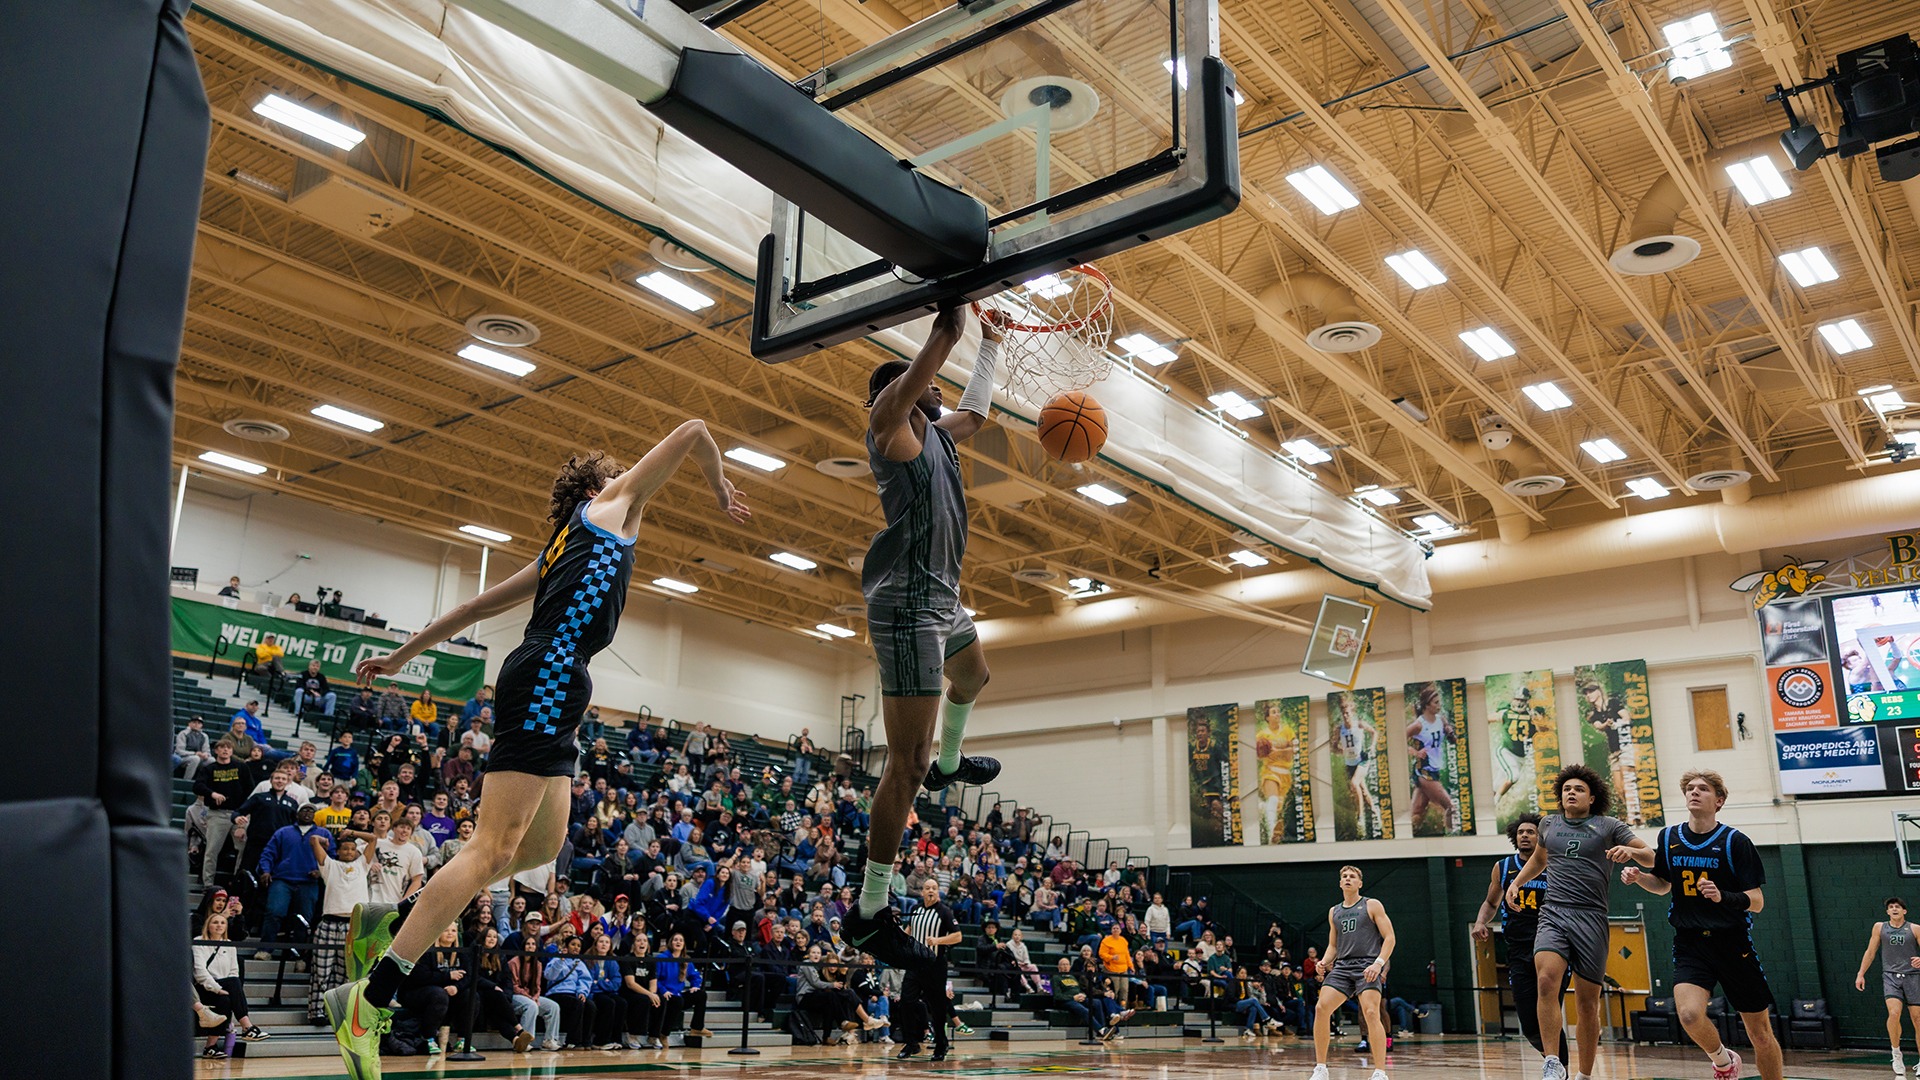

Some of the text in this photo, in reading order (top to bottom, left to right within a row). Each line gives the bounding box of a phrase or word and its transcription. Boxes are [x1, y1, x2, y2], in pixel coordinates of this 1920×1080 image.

[1884, 531, 1920, 567] B
[1783, 625, 1819, 634] Interstate
[322, 643, 347, 664] TO
[401, 661, 434, 679] RENA
[1783, 691, 1821, 707] INCORPORATED
[1881, 695, 1904, 704] REBS
[1886, 706, 1903, 716] 23
[1431, 730, 1441, 748] H
[1508, 719, 1530, 742] 43
[1345, 734, 1355, 748] H
[1783, 740, 1875, 752] ORTHOPEDICS AND
[1455, 737, 1469, 773] CROSS
[1782, 747, 1875, 760] SPORTS MEDICINE
[1227, 707, 1243, 844] MEN'S BASKETBALL
[1298, 702, 1314, 840] WOMEN'S BASKETBALL
[1377, 754, 1390, 795] CROSS
[1632, 725, 1663, 821] WOMEN'S
[1458, 777, 1473, 832] WOMEN'S
[1295, 796, 1305, 841] YELLOW
[1380, 797, 1393, 840] MEN'S
[1564, 839, 1581, 858] 2
[1672, 855, 1720, 869] SKYHAWKS
[1518, 889, 1538, 909] 14
[1340, 918, 1357, 935] 30
[1889, 934, 1906, 946] 24
